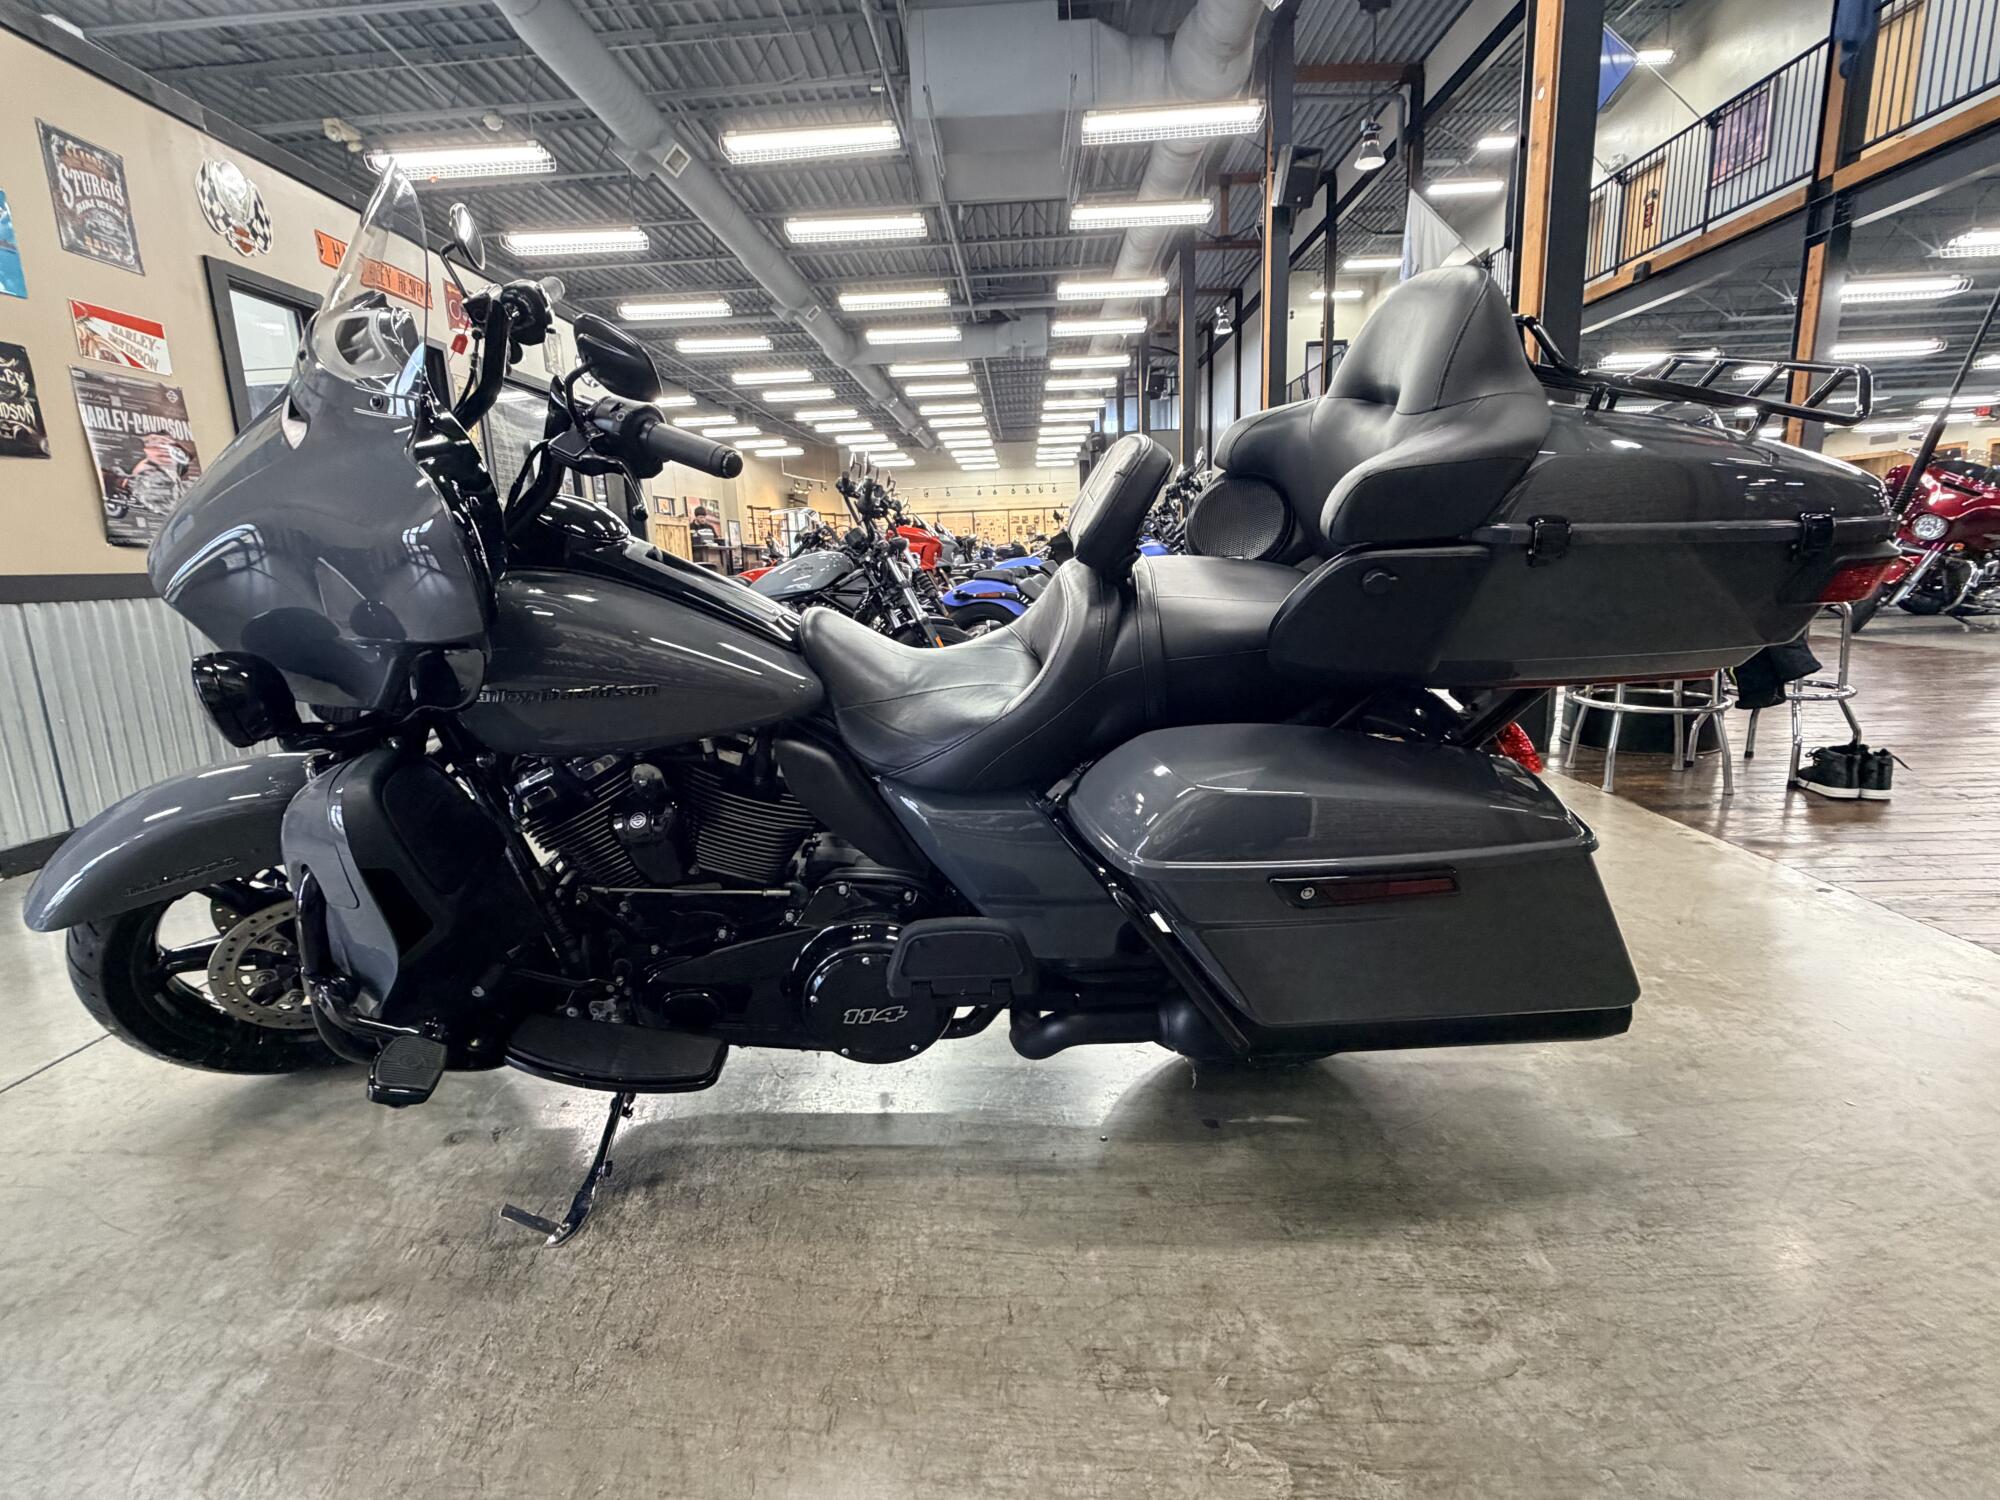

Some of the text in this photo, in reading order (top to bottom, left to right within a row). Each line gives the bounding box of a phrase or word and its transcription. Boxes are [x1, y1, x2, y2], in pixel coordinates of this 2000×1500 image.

[57, 163, 125, 209] STURGIS
[108, 332, 159, 371] DAVIDSON
[78, 402, 194, 442] HARLEY-DAVIDSON
[843, 1005, 908, 1025] 114
